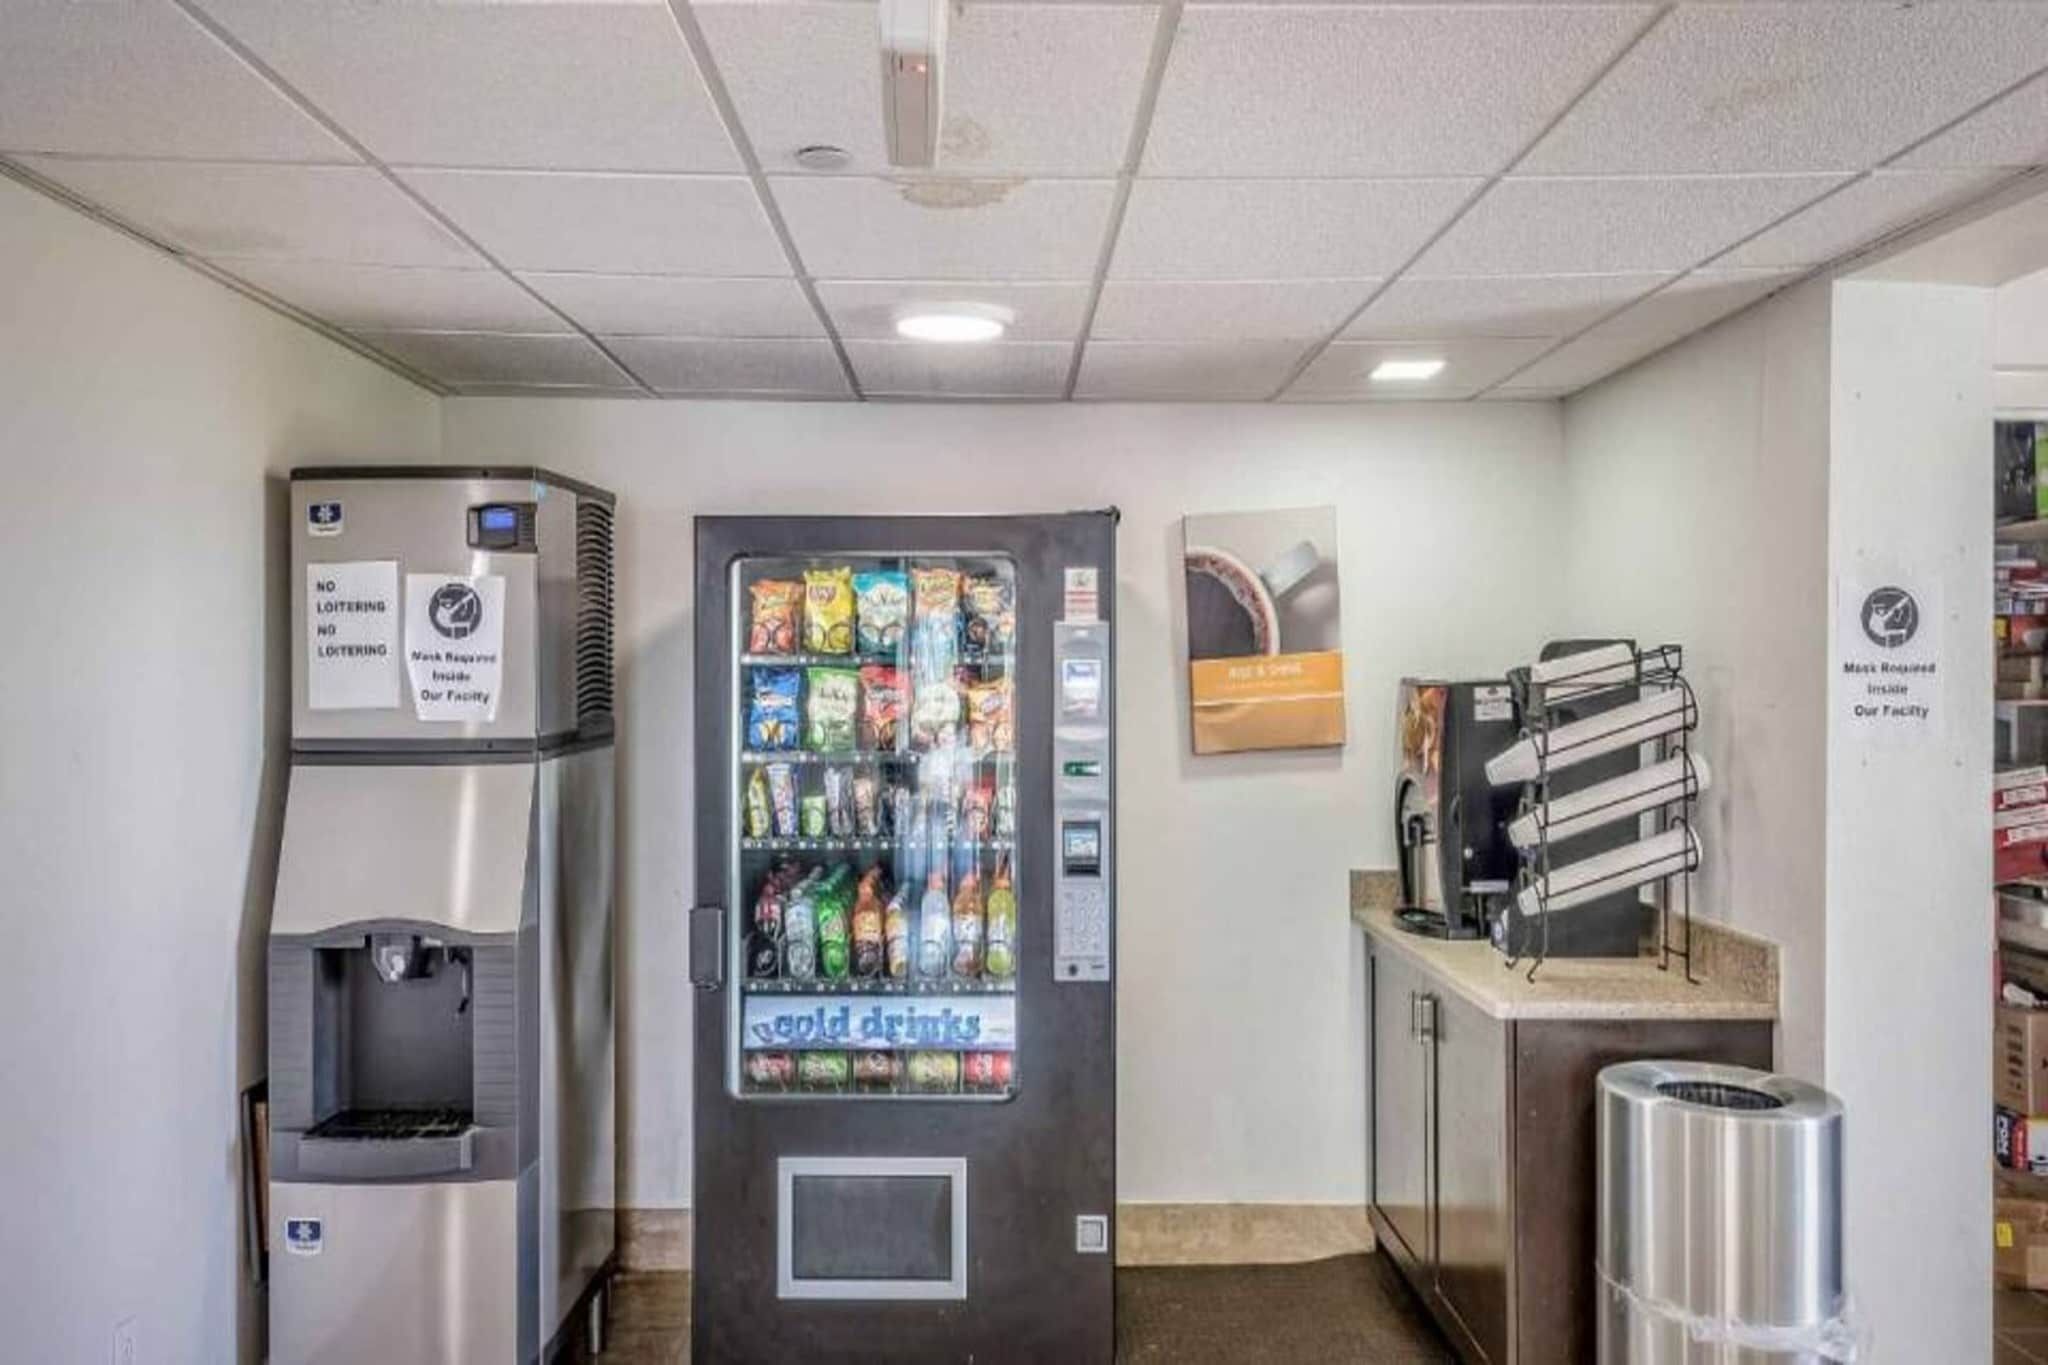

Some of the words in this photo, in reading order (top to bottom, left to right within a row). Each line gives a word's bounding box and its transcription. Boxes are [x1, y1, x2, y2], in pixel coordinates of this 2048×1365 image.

[317, 580, 336, 592] NO
[317, 600, 386, 614] LOITERING
[317, 624, 336, 636] NO
[318, 644, 387, 658] LOITERING
[411, 651, 442, 661] Mask
[1844, 662, 1876, 674] Mask
[1881, 662, 1936, 676] Required
[432, 670, 471, 681] Inside
[421, 689, 443, 701] Our
[1867, 684, 1908, 696] Inside
[1855, 704, 1878, 717] Our
[774, 1006, 850, 1041] cold
[861, 1006, 981, 1042] drinks
